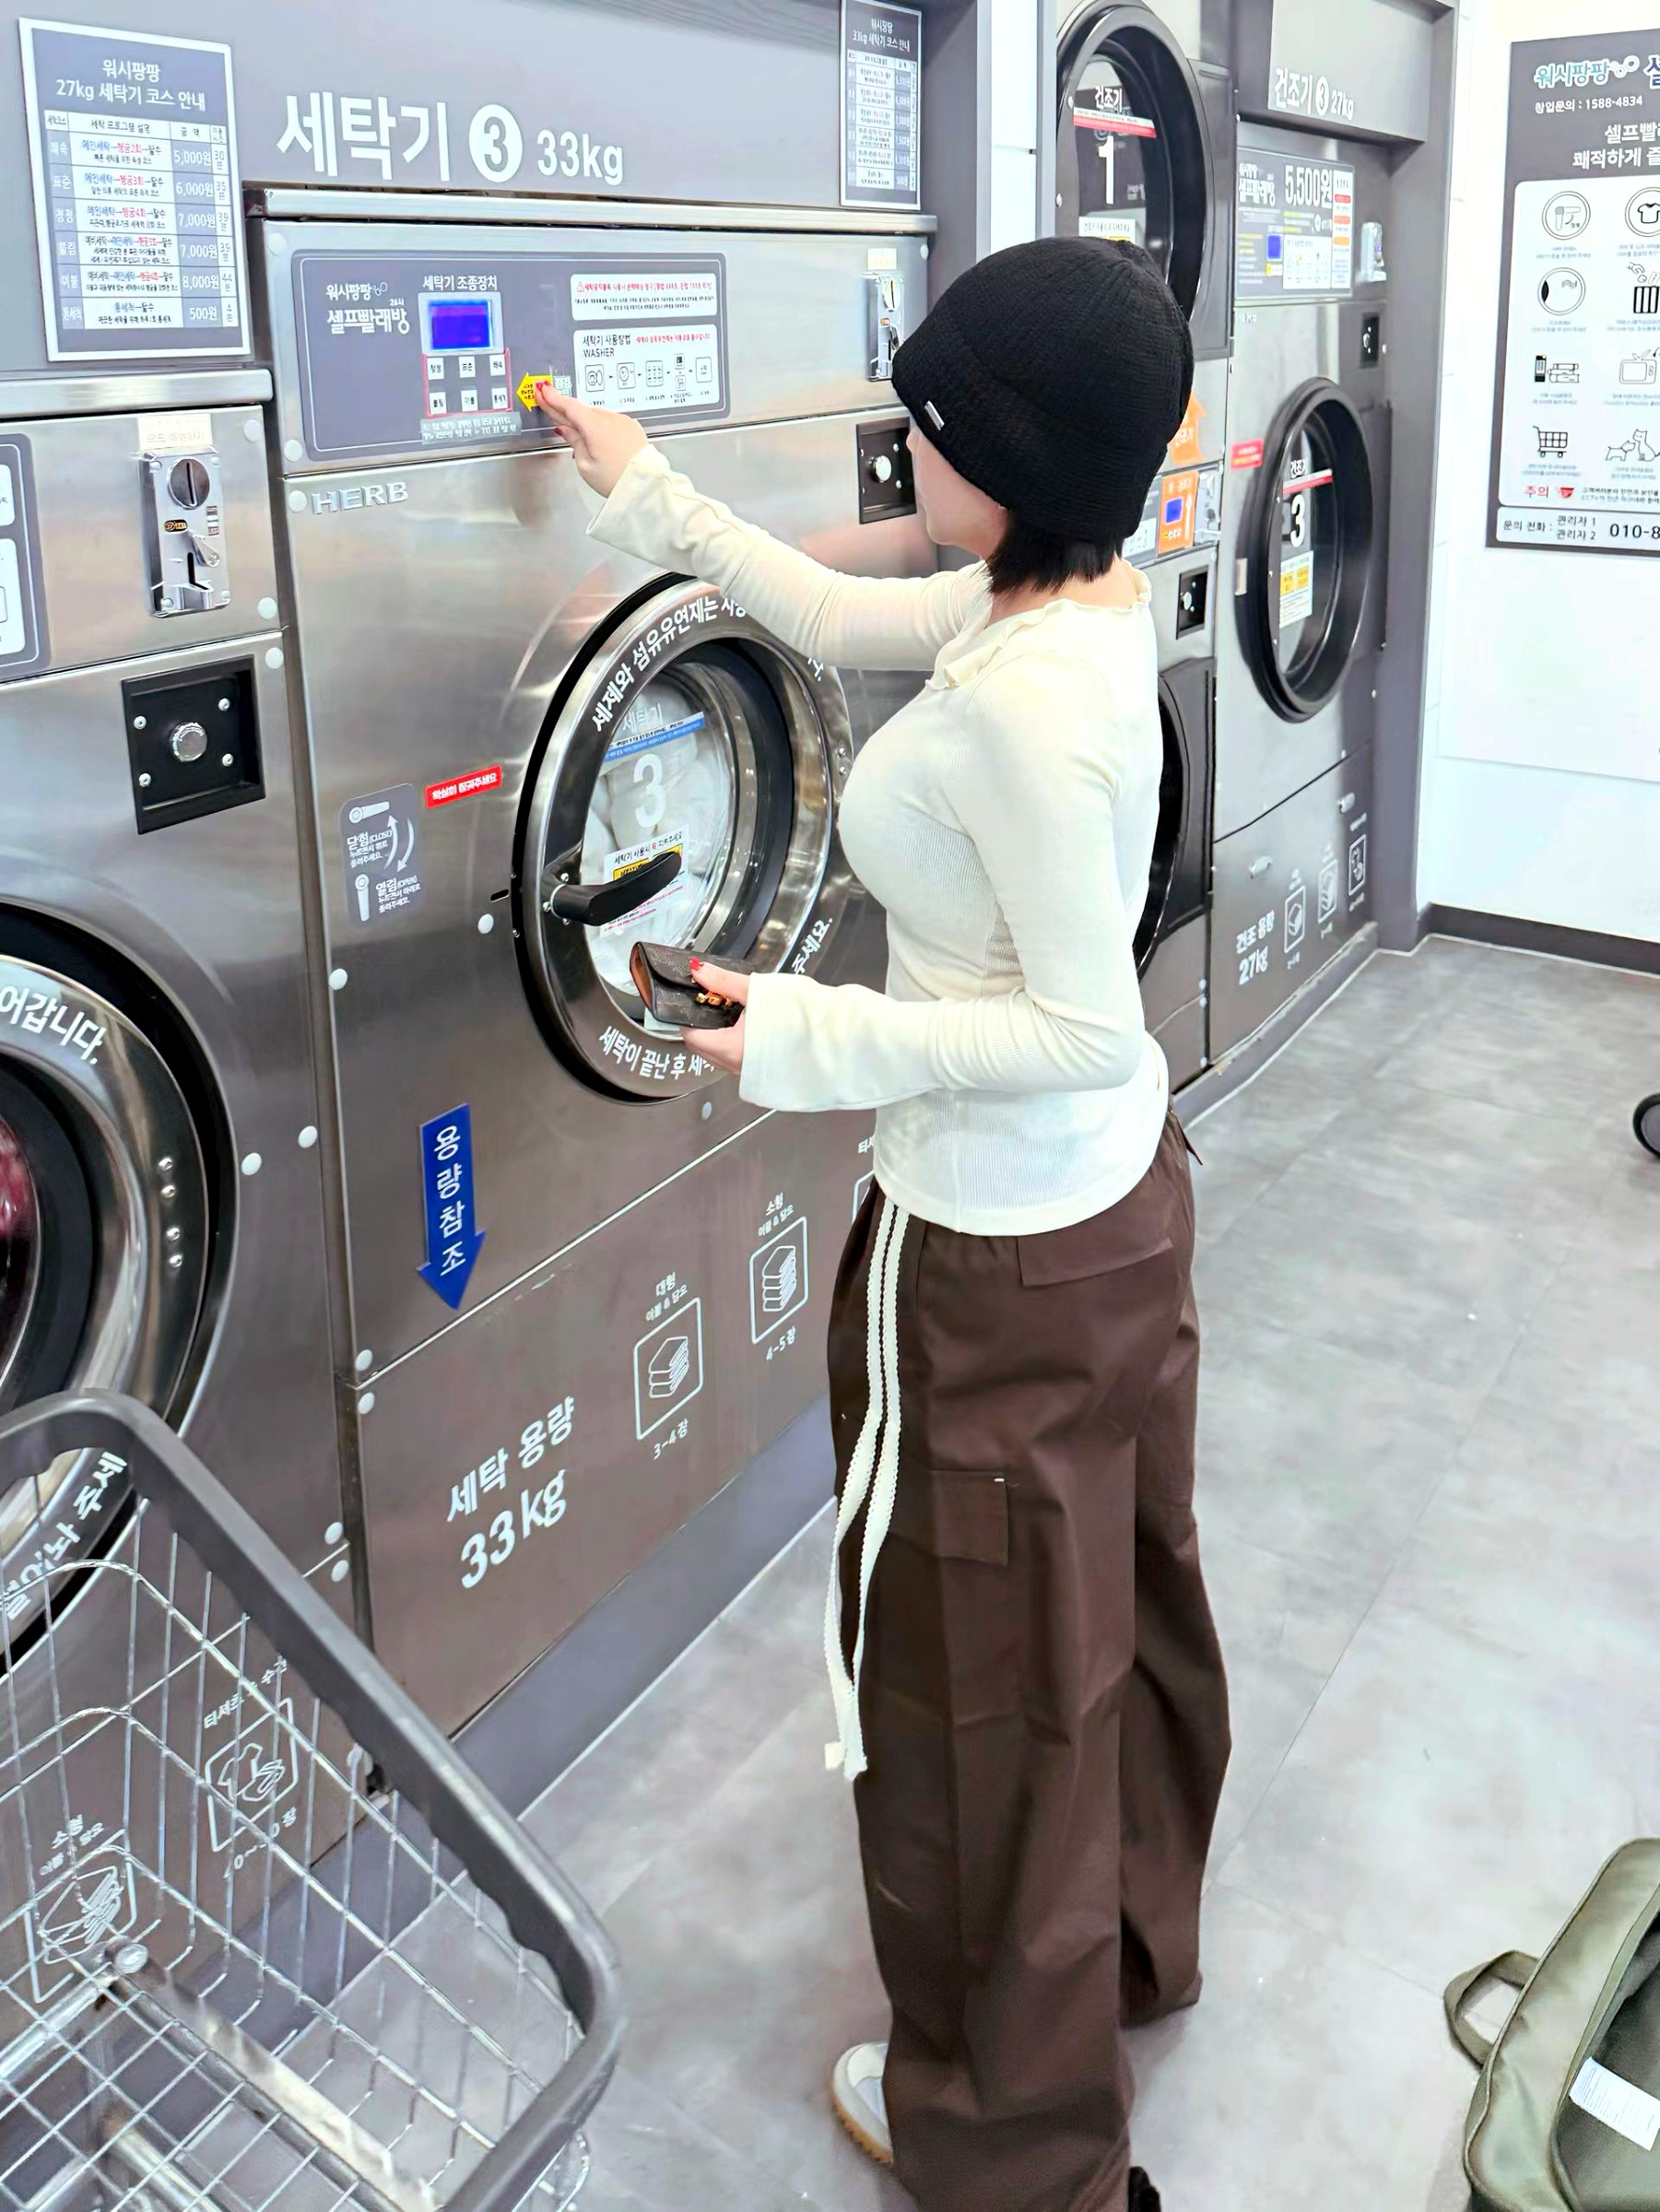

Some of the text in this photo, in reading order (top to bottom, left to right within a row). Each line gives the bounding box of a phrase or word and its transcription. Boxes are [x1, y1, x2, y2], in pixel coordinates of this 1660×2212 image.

[102, 59, 160, 83] 워시팡팡
[1535, 60, 1609, 88] 워시팡팡
[56, 79, 206, 112] 27kg 세탁기 코스 안내
[1094, 85, 1122, 113] 건조기
[1275, 67, 1313, 115] 건조기
[1331, 89, 1353, 121] 27kg
[1585, 96, 1643, 110] 1588-4834
[277, 91, 450, 182] 세탁기
[536, 129, 624, 186] 33kg
[1605, 122, 1660, 144] 셀프빨
[174, 150, 212, 165] 5,000원
[1572, 147, 1642, 170] 쾌적하게
[1099, 135, 1113, 205] 1
[176, 182, 214, 197] 6,000원
[1285, 165, 1332, 208] 5,500원
[178, 213, 216, 228] 7,000원
[181, 244, 218, 259] 7,000원
[182, 275, 220, 289] 8,000원
[325, 282, 372, 300] 워시팡팡
[422, 276, 454, 291] 세탁기
[189, 307, 218, 321] 500원
[327, 307, 410, 335] 셀프빨래방
[583, 335, 604, 347] 세탁기
[583, 347, 615, 359] WASHER
[312, 481, 410, 516] HERB
[1525, 485, 1549, 499] 주의
[1290, 494, 1305, 547] 3
[1557, 514, 1589, 527] 관리자
[1610, 523, 1660, 539] 010-8
[1557, 528, 1587, 541] 관리자
[592, 663, 636, 733] 세제와
[632, 595, 719, 672] 섬유유연제는
[633, 753, 666, 829] 3
[598, 1025, 642, 1072] 세탁이
[640, 1050, 670, 1080] 끝난
[670, 1053, 686, 1080] 후
[654, 1418, 689, 1460] 3-4장
[446, 1396, 575, 1523] 세탁 용량
